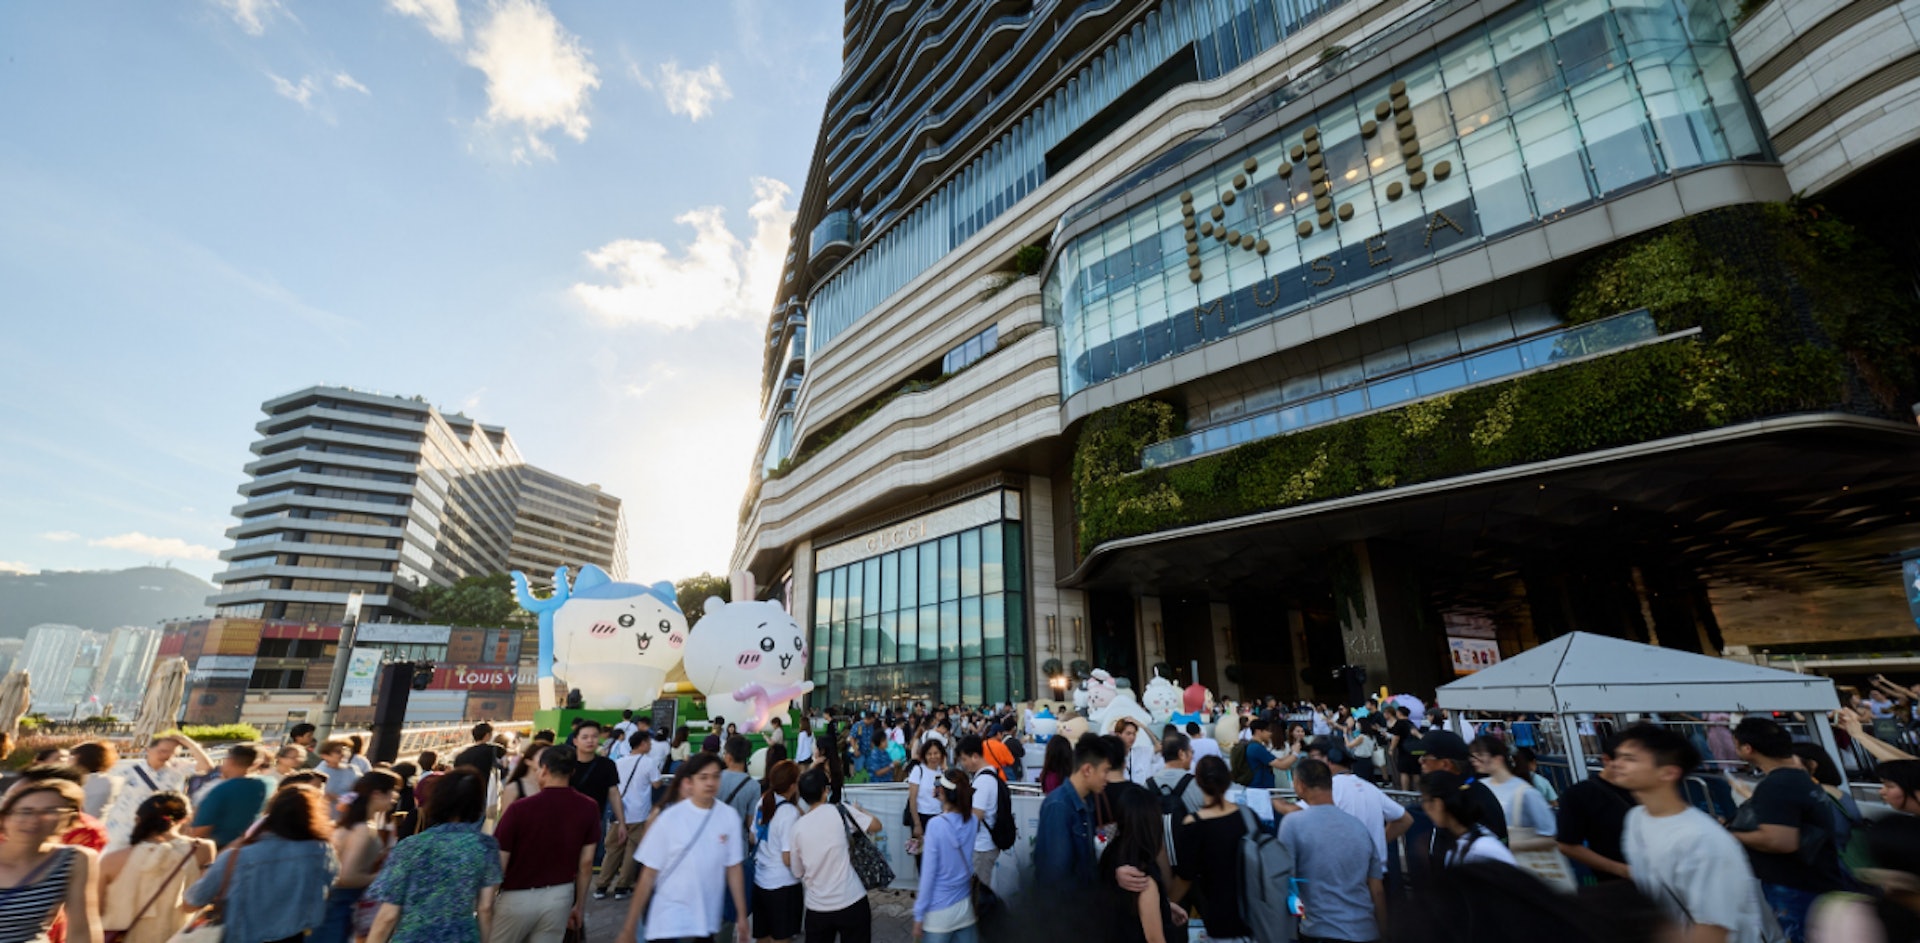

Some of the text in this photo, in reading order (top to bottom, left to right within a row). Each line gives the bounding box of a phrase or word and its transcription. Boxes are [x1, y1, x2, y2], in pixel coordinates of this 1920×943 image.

[1181, 80, 1451, 283] K11
[1194, 209, 1463, 332] MUSEA
[866, 522, 926, 551] GUCCI
[458, 672, 503, 684] LOUIS
